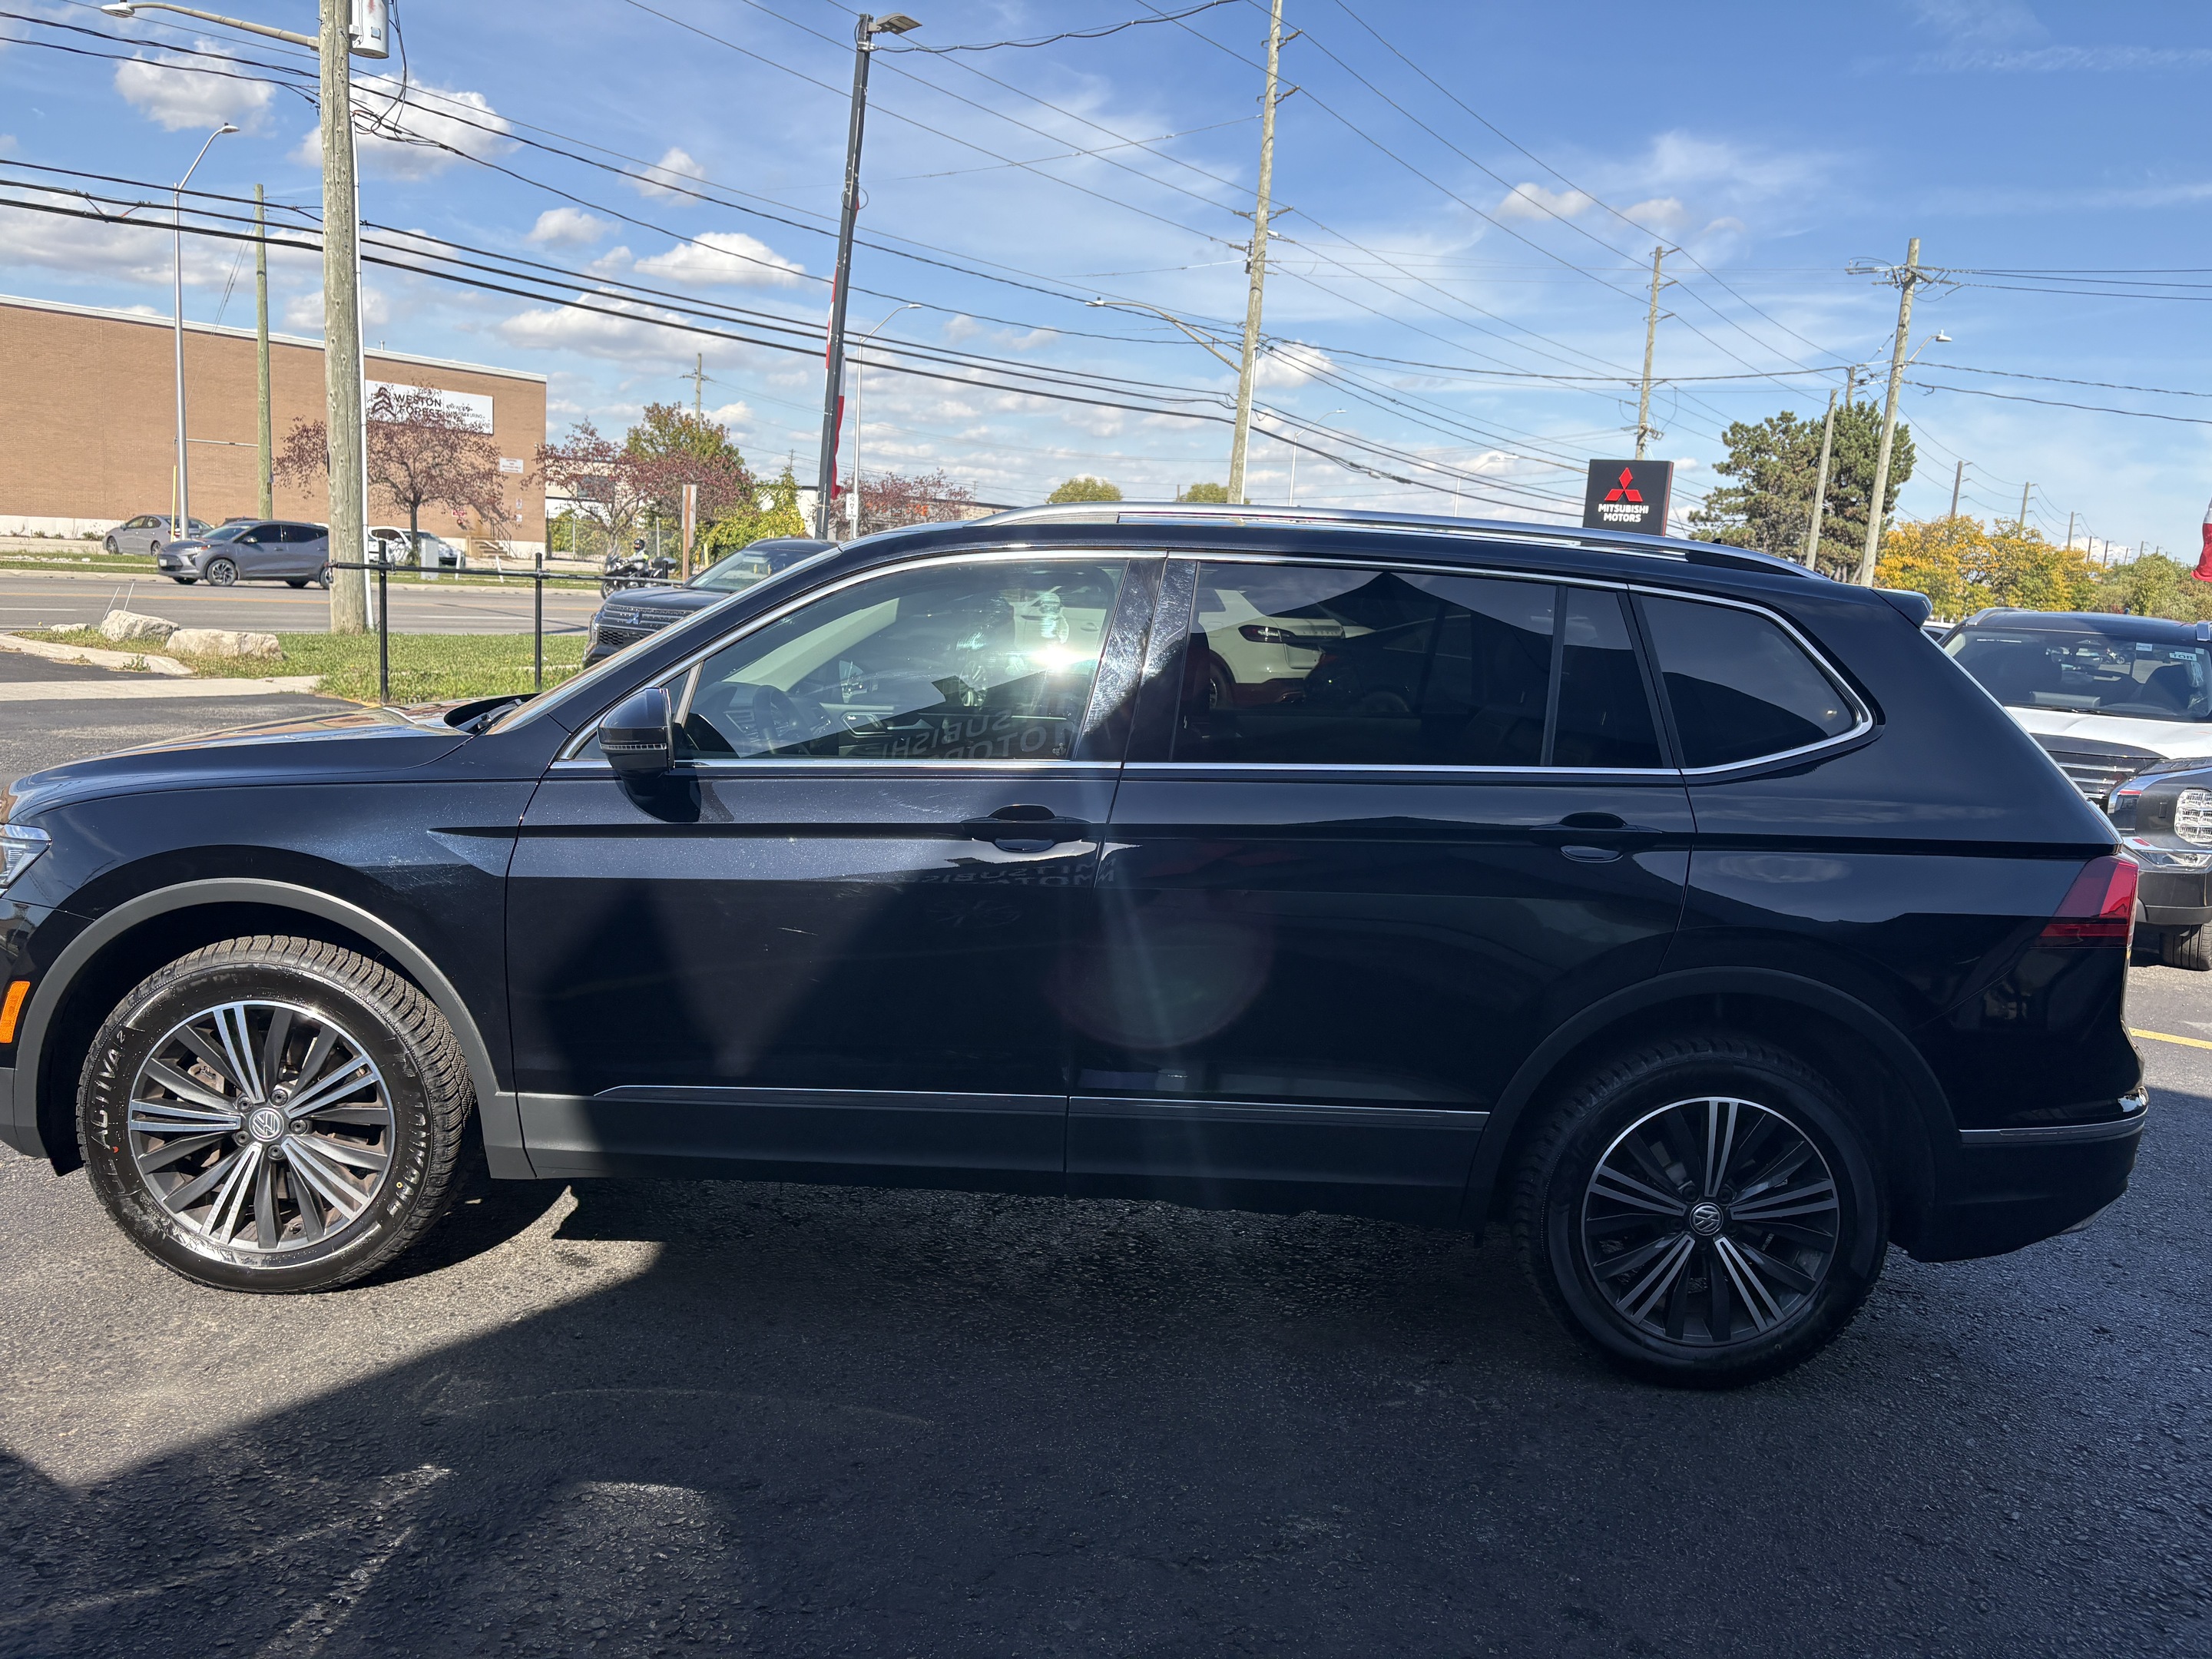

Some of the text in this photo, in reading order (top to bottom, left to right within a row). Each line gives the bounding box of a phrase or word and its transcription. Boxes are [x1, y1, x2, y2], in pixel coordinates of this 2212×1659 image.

[394, 393, 442, 408] WESTON
[1598, 504, 1649, 514] MITSUBISHI
[1604, 513, 1641, 522] MOTORS
